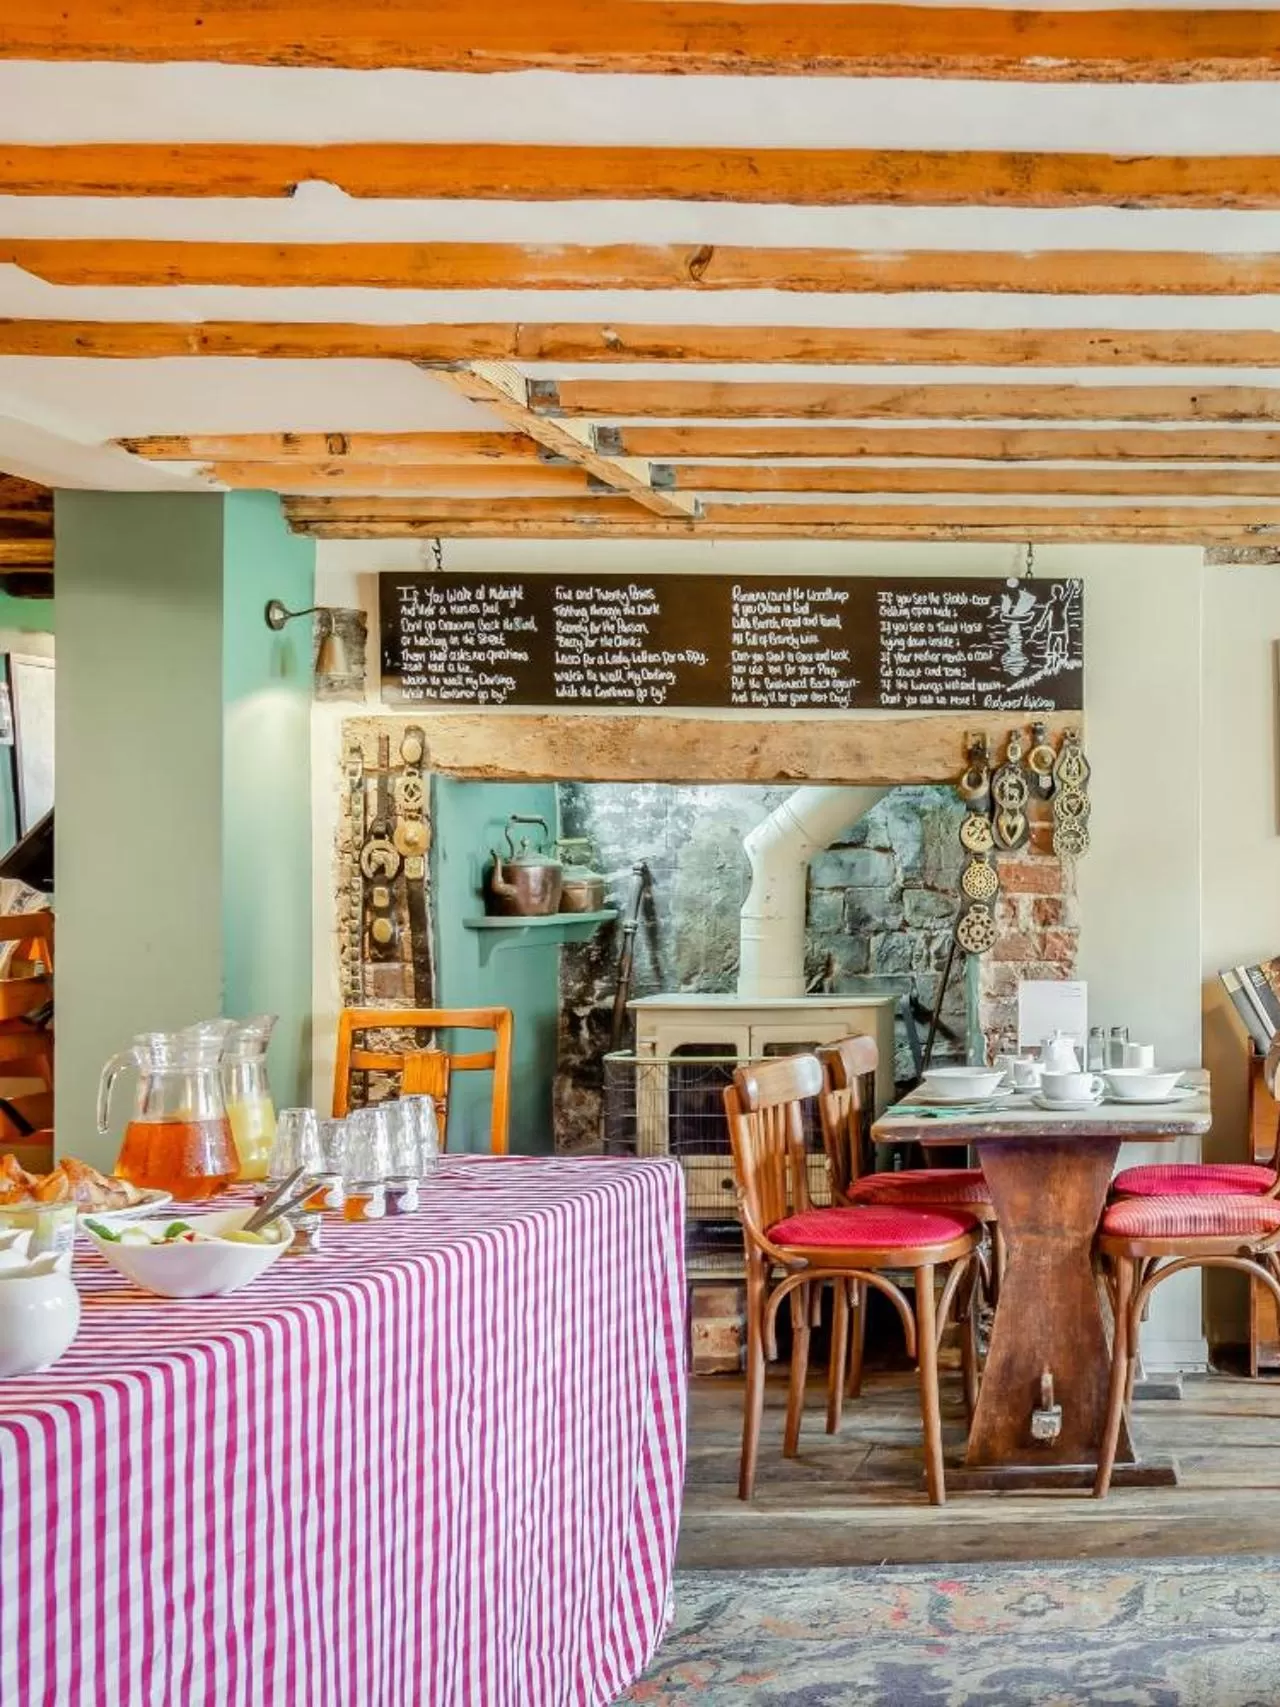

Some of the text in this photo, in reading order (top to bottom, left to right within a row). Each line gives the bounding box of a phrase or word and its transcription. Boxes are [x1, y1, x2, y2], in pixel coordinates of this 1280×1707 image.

[877, 592, 893, 605] If
[440, 606, 448, 615] a
[927, 623, 935, 632] a
[597, 655, 605, 664] a
[677, 653, 686, 662] a
[967, 653, 974, 662] a
[448, 663, 456, 672] a
[636, 688, 648, 703] go
